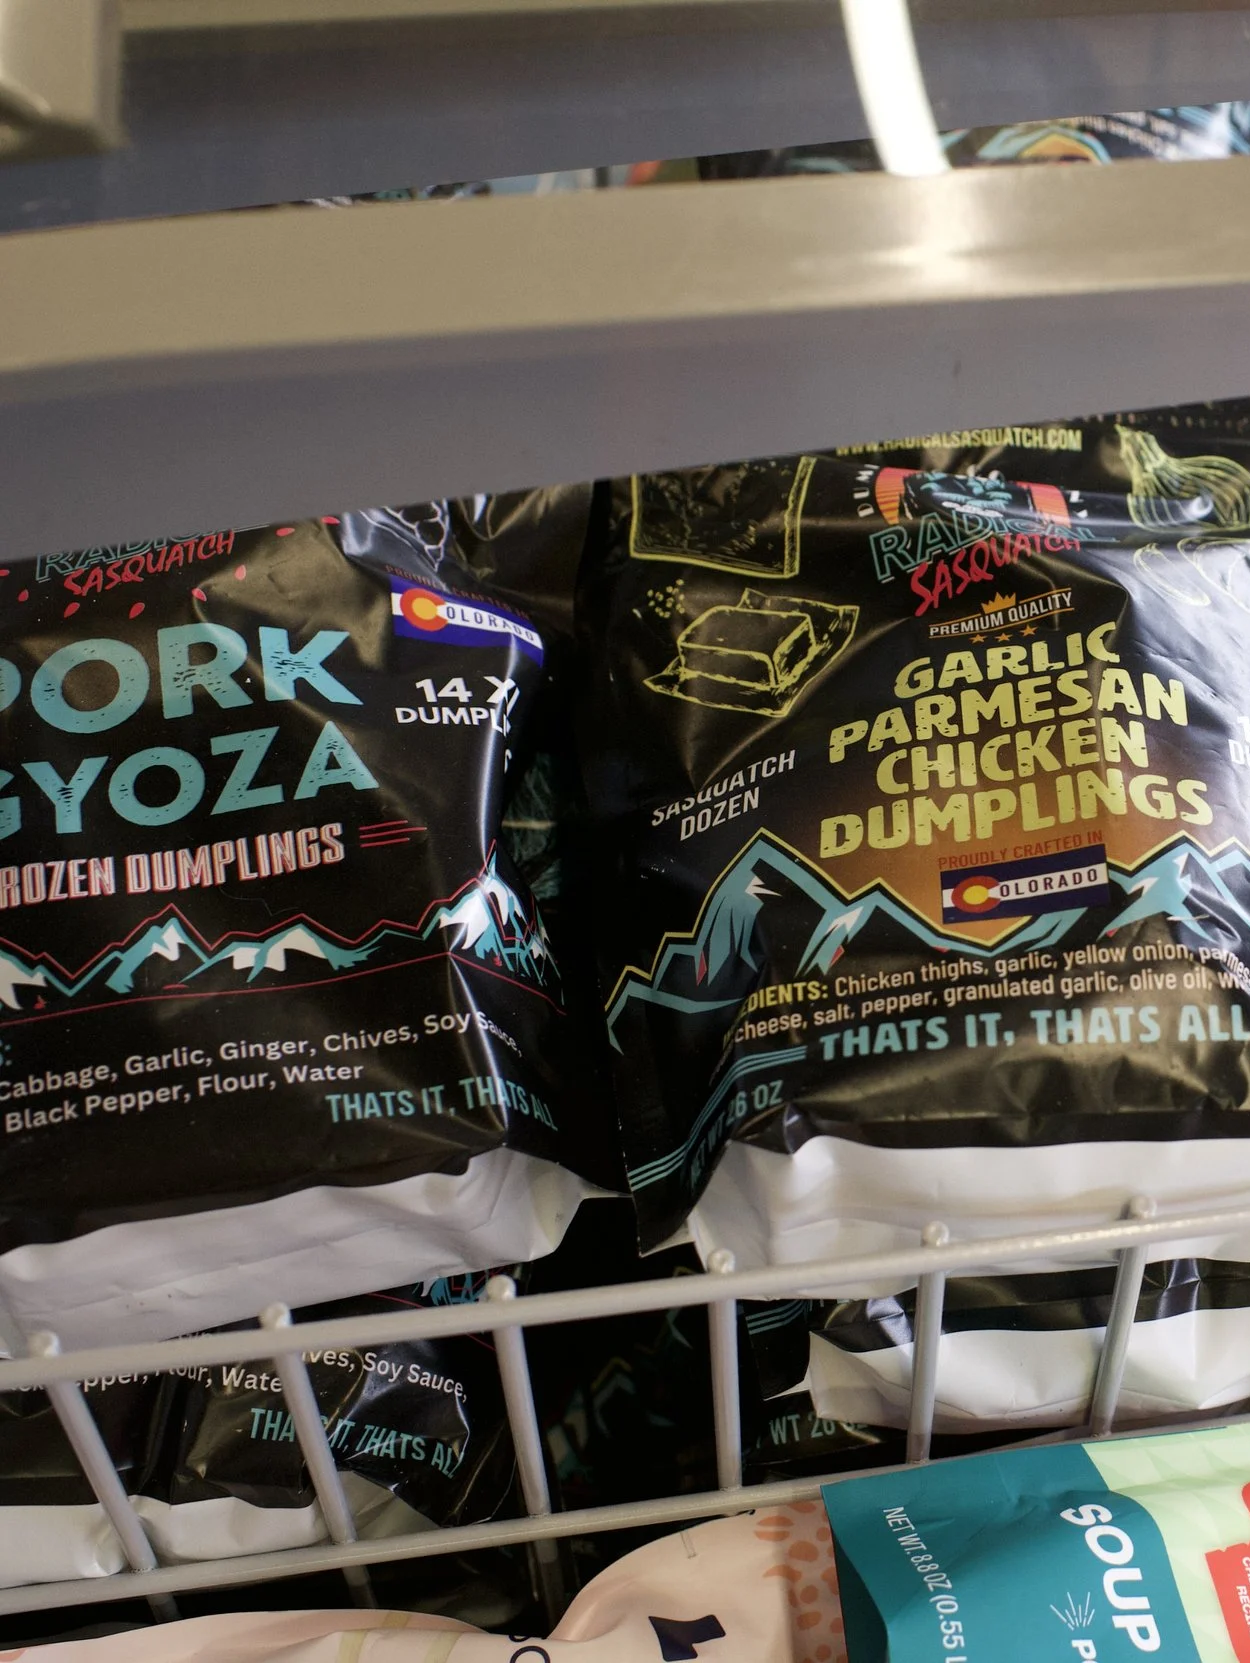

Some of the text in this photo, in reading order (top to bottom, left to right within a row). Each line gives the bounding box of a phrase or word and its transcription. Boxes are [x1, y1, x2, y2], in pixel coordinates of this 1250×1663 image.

[63, 529, 235, 596] SASQUATCH
[869, 511, 1120, 582] RADICAL
[910, 531, 1081, 616] SASQUATCH
[930, 592, 1073, 636] PREMIUM QUALITY
[894, 621, 1121, 700] GARLIC
[415, 677, 473, 703] 14
[828, 668, 1189, 763] PARMESAN
[876, 717, 1149, 796] CHICKEN
[652, 750, 796, 827] SASQUATCH
[680, 786, 760, 841] DOZEN
[819, 768, 1214, 859] DUMPLINGS
[0, 822, 346, 910] ROZEN DUMPLINGS
[937, 830, 1104, 871] PROUDLY CRAFTED IN
[835, 968, 915, 997] Chicken
[921, 957, 989, 983] thighs,
[995, 952, 1058, 978] garlic,
[1063, 944, 1129, 969] yellow
[1133, 940, 1194, 963] onion,
[734, 1010, 808, 1043] cheese,
[814, 1002, 855, 1026] salt,
[861, 990, 938, 1018] pepper,
[944, 972, 1054, 1007] granulated
[1060, 971, 1124, 999] garlic,
[1130, 969, 1177, 991] olive
[1184, 967, 1212, 991] oil,
[820, 1016, 949, 1061] THATS
[965, 1012, 1015, 1048] IT,
[1030, 1005, 1162, 1045] THATS
[0, 1010, 523, 1101] Cabbage, Garlic, Ginger, Chives, Soy Sauce,
[5, 1063, 364, 1133] Black Pepper, Flour, Water
[326, 1075, 559, 1131] THATS IT, THATS ALL
[751, 1079, 784, 1110] OZ
[221, 1366, 283, 1393] Wate
[363, 1352, 403, 1383] Soy
[407, 1363, 468, 1403] Sauce,
[356, 1424, 427, 1461] THATS
[769, 1414, 801, 1446] WT
[883, 1506, 916, 1534] NET
[898, 1532, 927, 1556] WT.
[910, 1554, 940, 1574] 8.8
[923, 1572, 953, 1592] OZ
[1059, 1504, 1161, 1653] SOUP
[929, 1593, 966, 1650] (0.55
